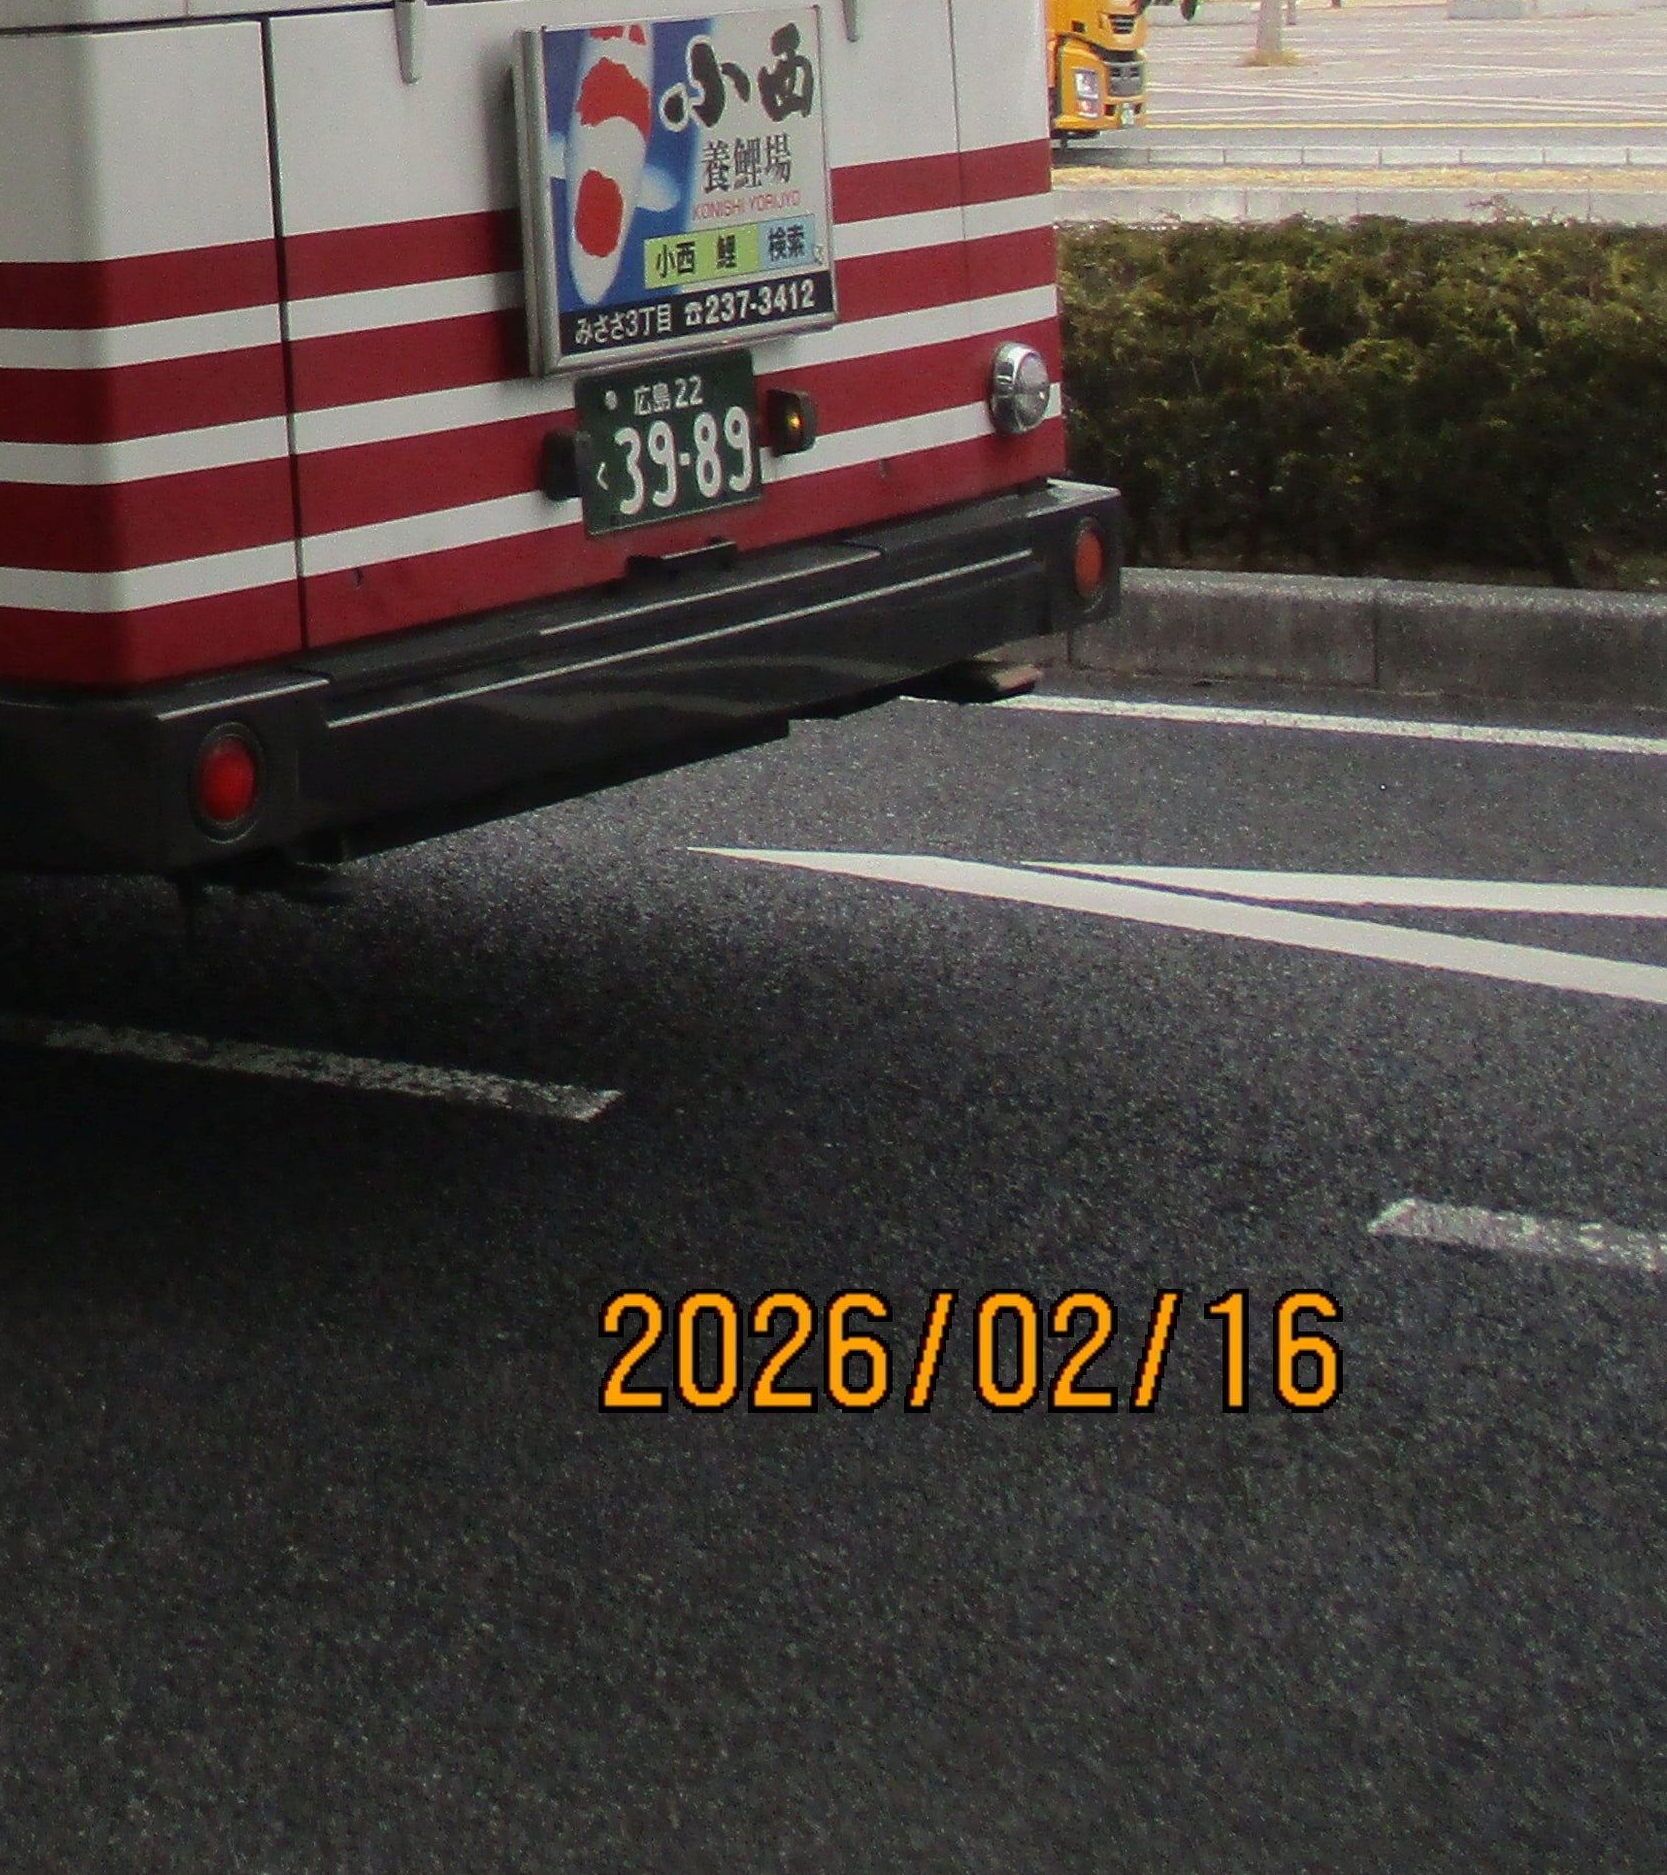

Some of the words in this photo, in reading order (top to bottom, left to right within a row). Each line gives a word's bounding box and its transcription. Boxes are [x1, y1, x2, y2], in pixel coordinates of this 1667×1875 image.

[702, 132, 792, 195] 養鯉場
[692, 198, 746, 221] KONISHI
[655, 240, 696, 279] 小西
[768, 224, 806, 263] 検索
[705, 279, 815, 325] 237-3412
[597, 462, 608, 491] く
[615, 406, 752, 515] 39-89
